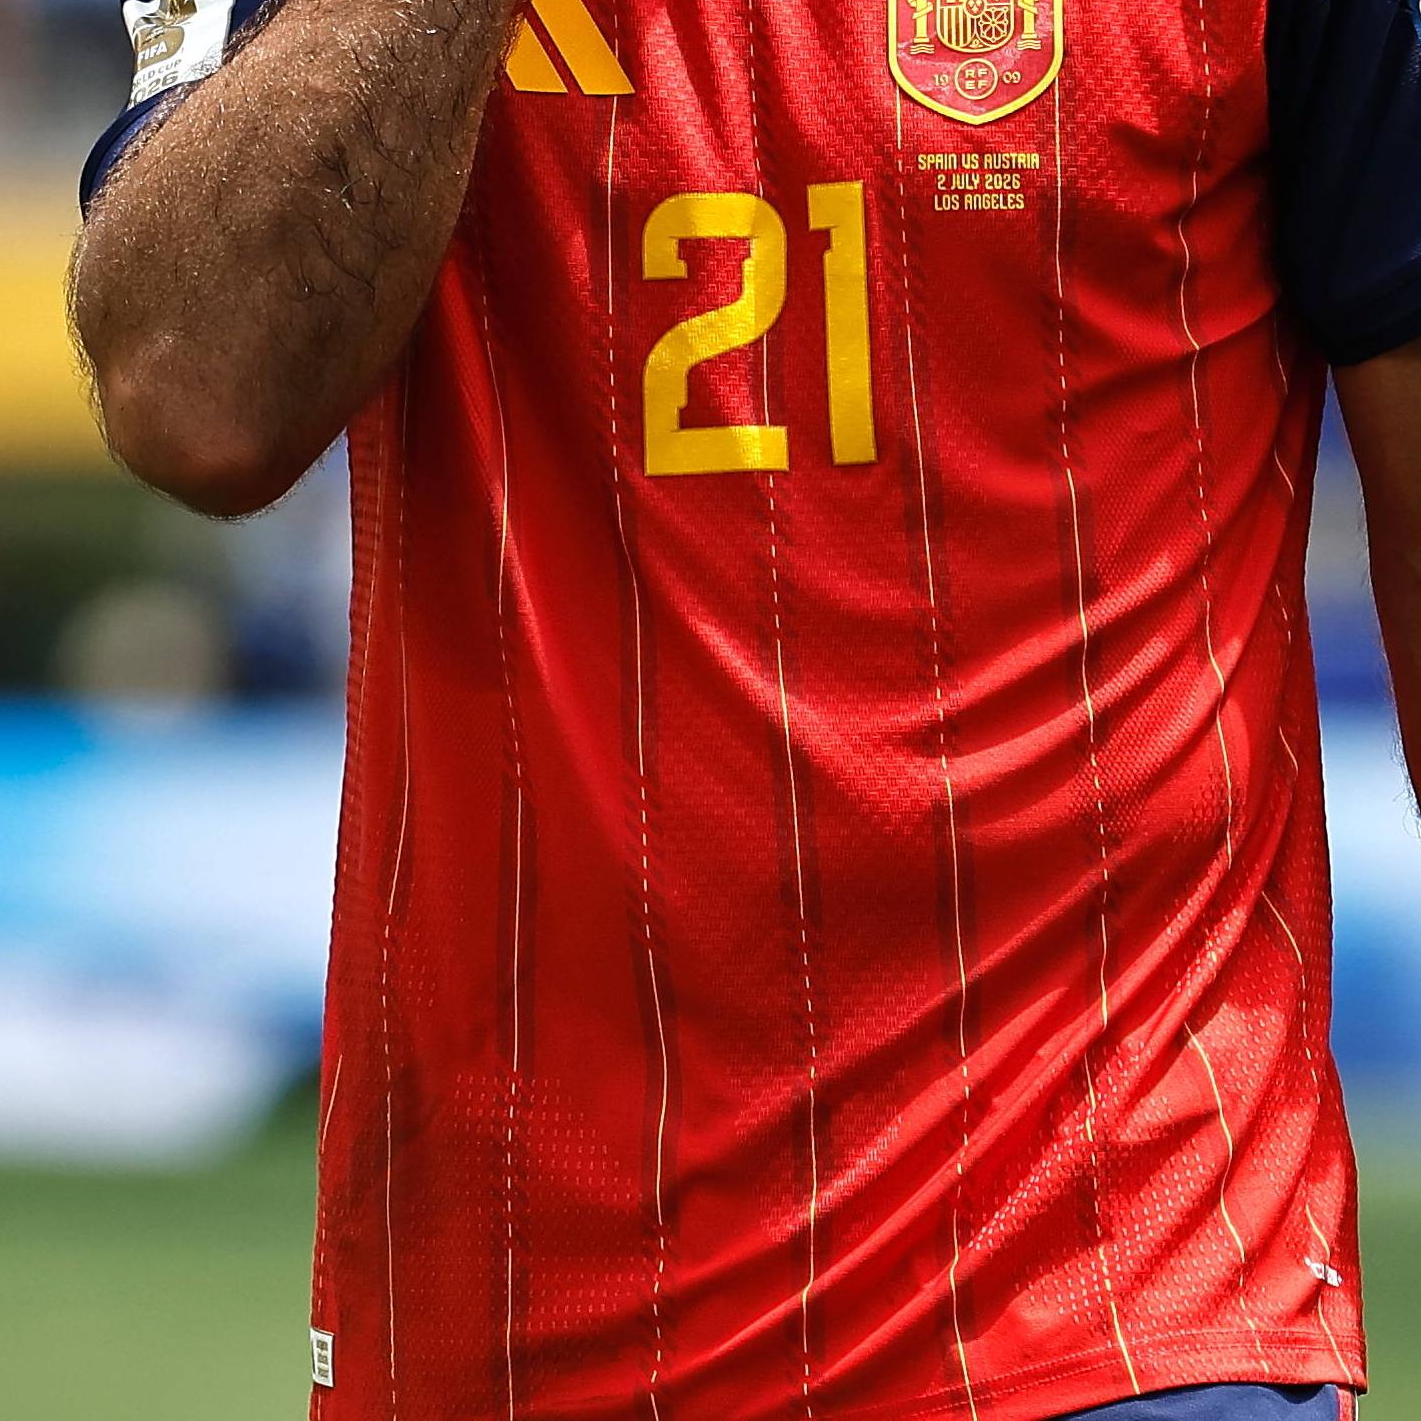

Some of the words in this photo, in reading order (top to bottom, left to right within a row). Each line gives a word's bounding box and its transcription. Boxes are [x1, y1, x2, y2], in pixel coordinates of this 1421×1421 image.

[137, 41, 168, 61] FIFA
[157, 59, 182, 74] CUP
[130, 70, 179, 106] 026
[918, 153, 957, 170] SPAIN
[984, 153, 1040, 170] AUSTRIA
[937, 174, 946, 190] 2
[950, 173, 980, 190] JULY
[984, 173, 1021, 190] 2026
[934, 194, 960, 211] LOS
[964, 193, 1025, 211] ANGELES
[642, 180, 877, 477] 21
